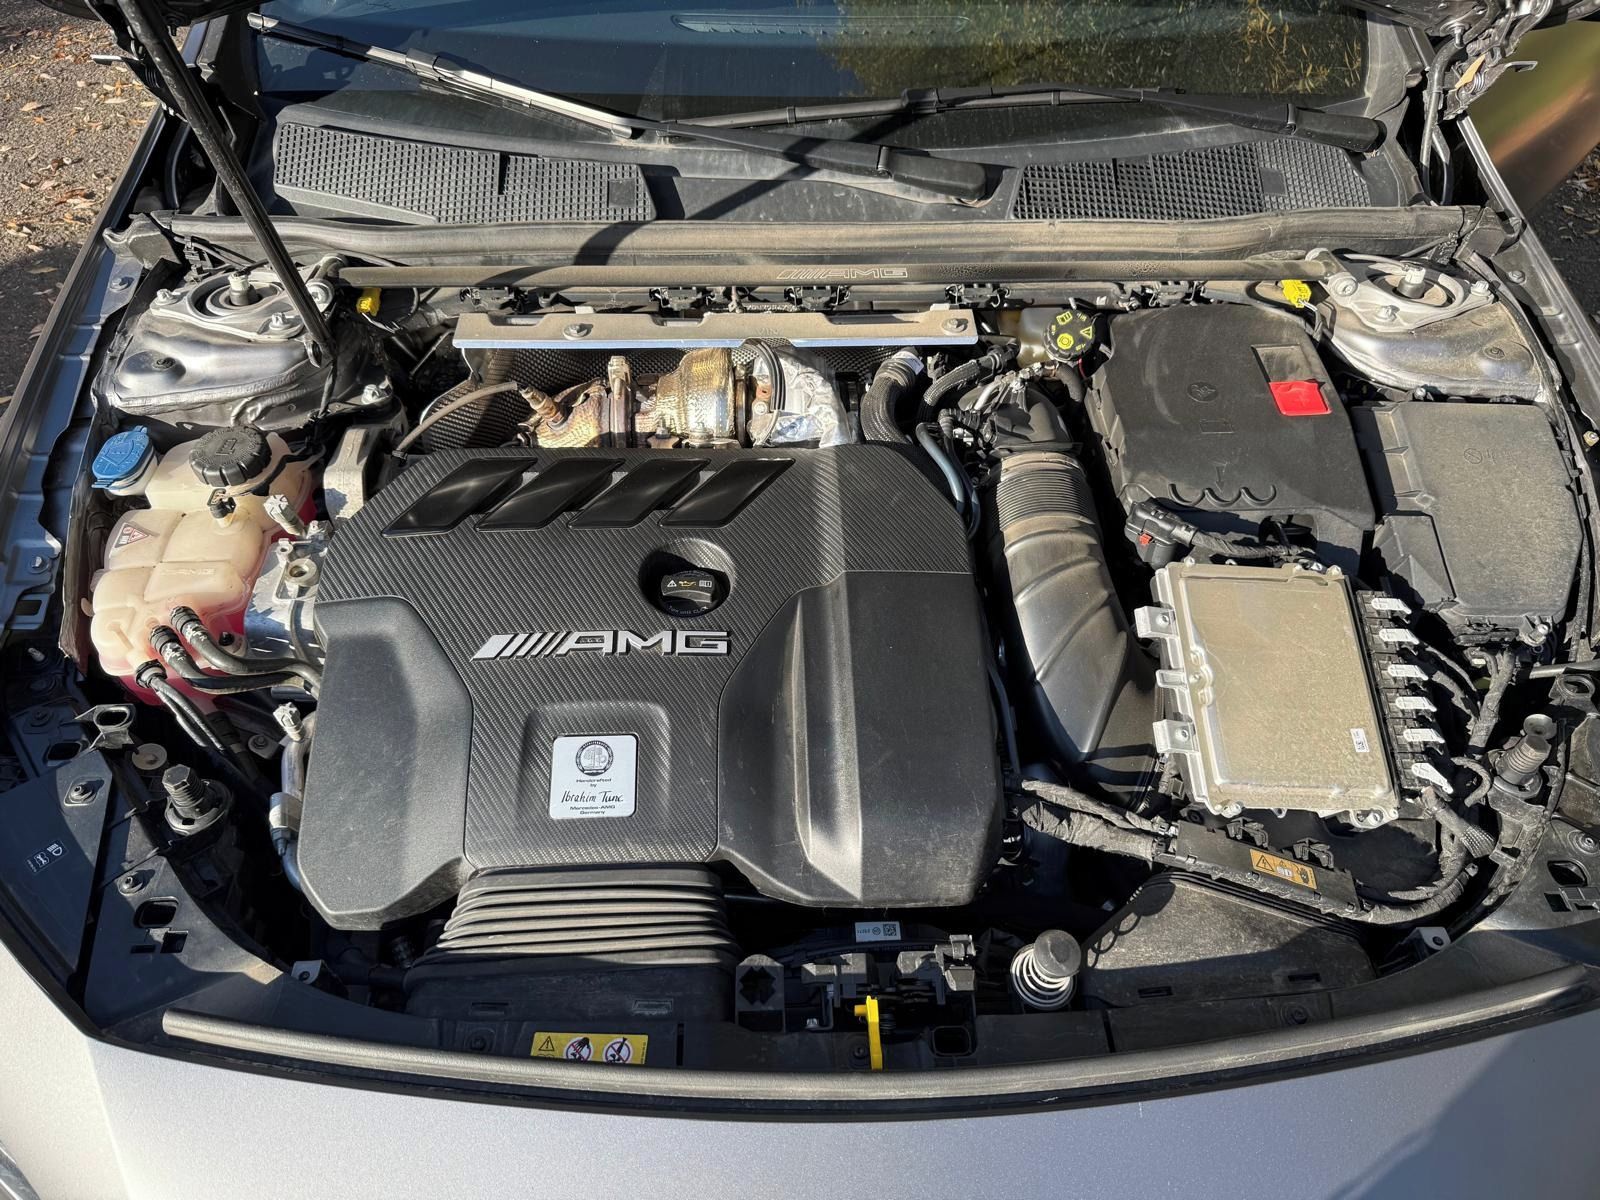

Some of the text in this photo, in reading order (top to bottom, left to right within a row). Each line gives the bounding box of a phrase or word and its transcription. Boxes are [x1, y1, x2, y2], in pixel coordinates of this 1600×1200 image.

[820, 267, 908, 279] AMG
[556, 630, 730, 656] AMG
[561, 790, 597, 803] Ibrahim
